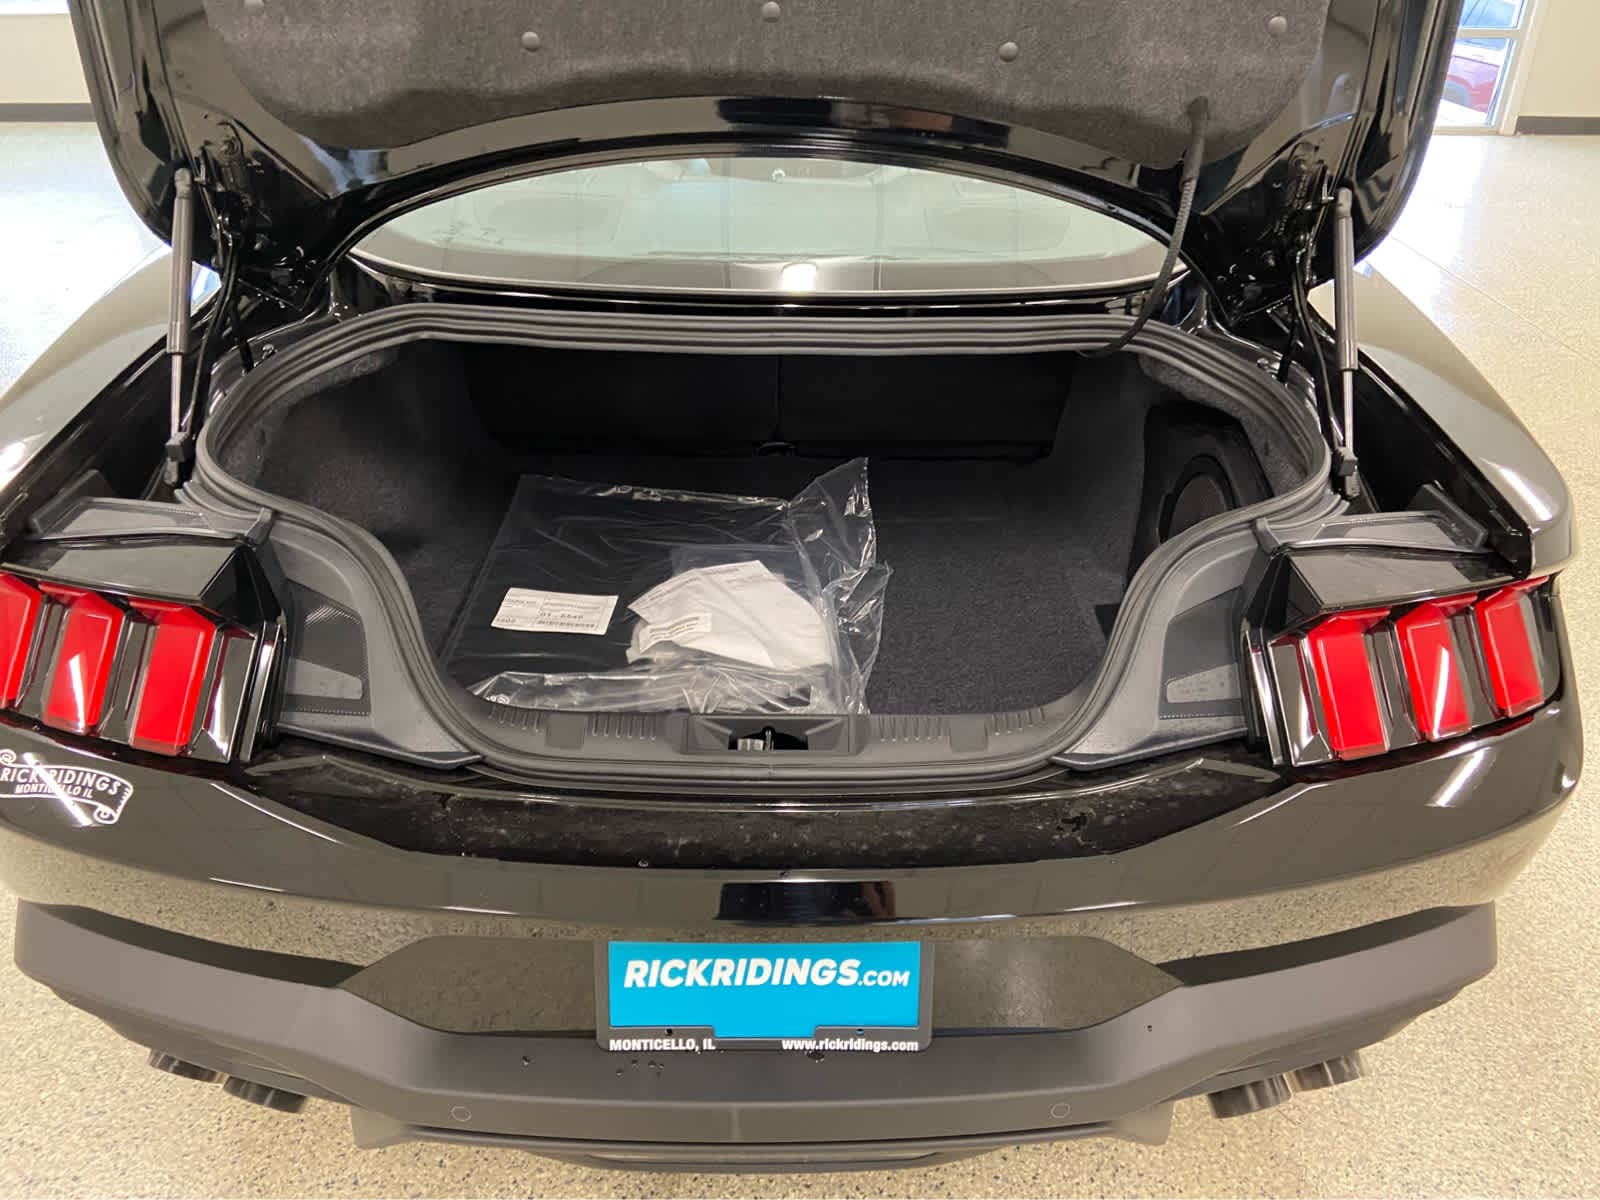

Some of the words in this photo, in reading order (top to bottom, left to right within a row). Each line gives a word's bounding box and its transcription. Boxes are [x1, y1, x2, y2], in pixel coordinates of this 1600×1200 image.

[0, 767, 43, 783] RICK
[48, 769, 121, 795] RIDINGS
[82, 788, 94, 799] IL
[623, 958, 910, 988] RICKRIDINGS.COM
[609, 1039, 699, 1052] MONTICELLO,
[703, 1039, 716, 1050] IL
[781, 1038, 919, 1052] www.rickridings.com
